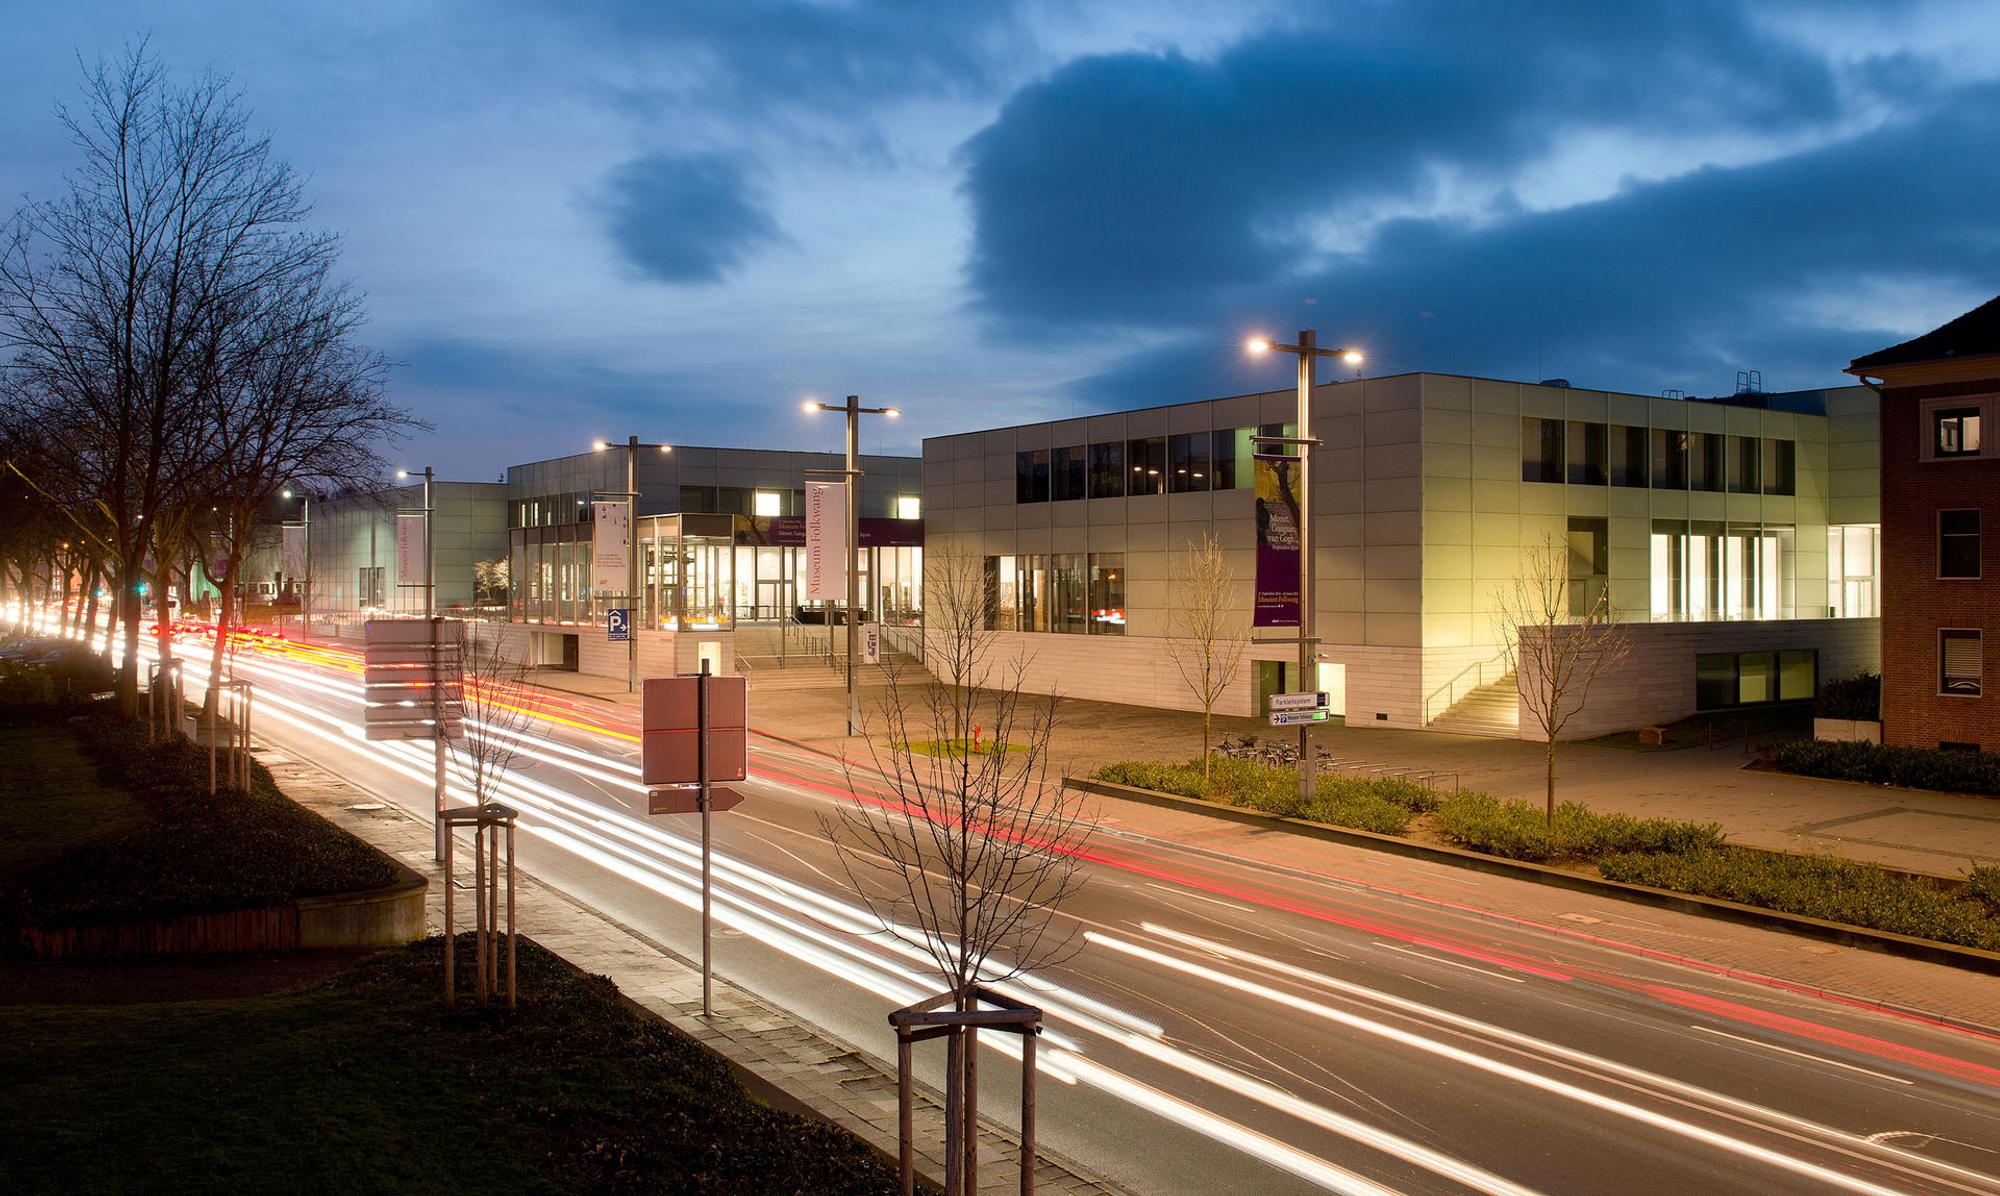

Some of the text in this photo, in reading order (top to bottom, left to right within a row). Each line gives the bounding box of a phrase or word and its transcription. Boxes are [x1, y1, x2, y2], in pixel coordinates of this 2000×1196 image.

[810, 487, 824, 594] Museum Folkwang
[610, 615, 622, 632] P
